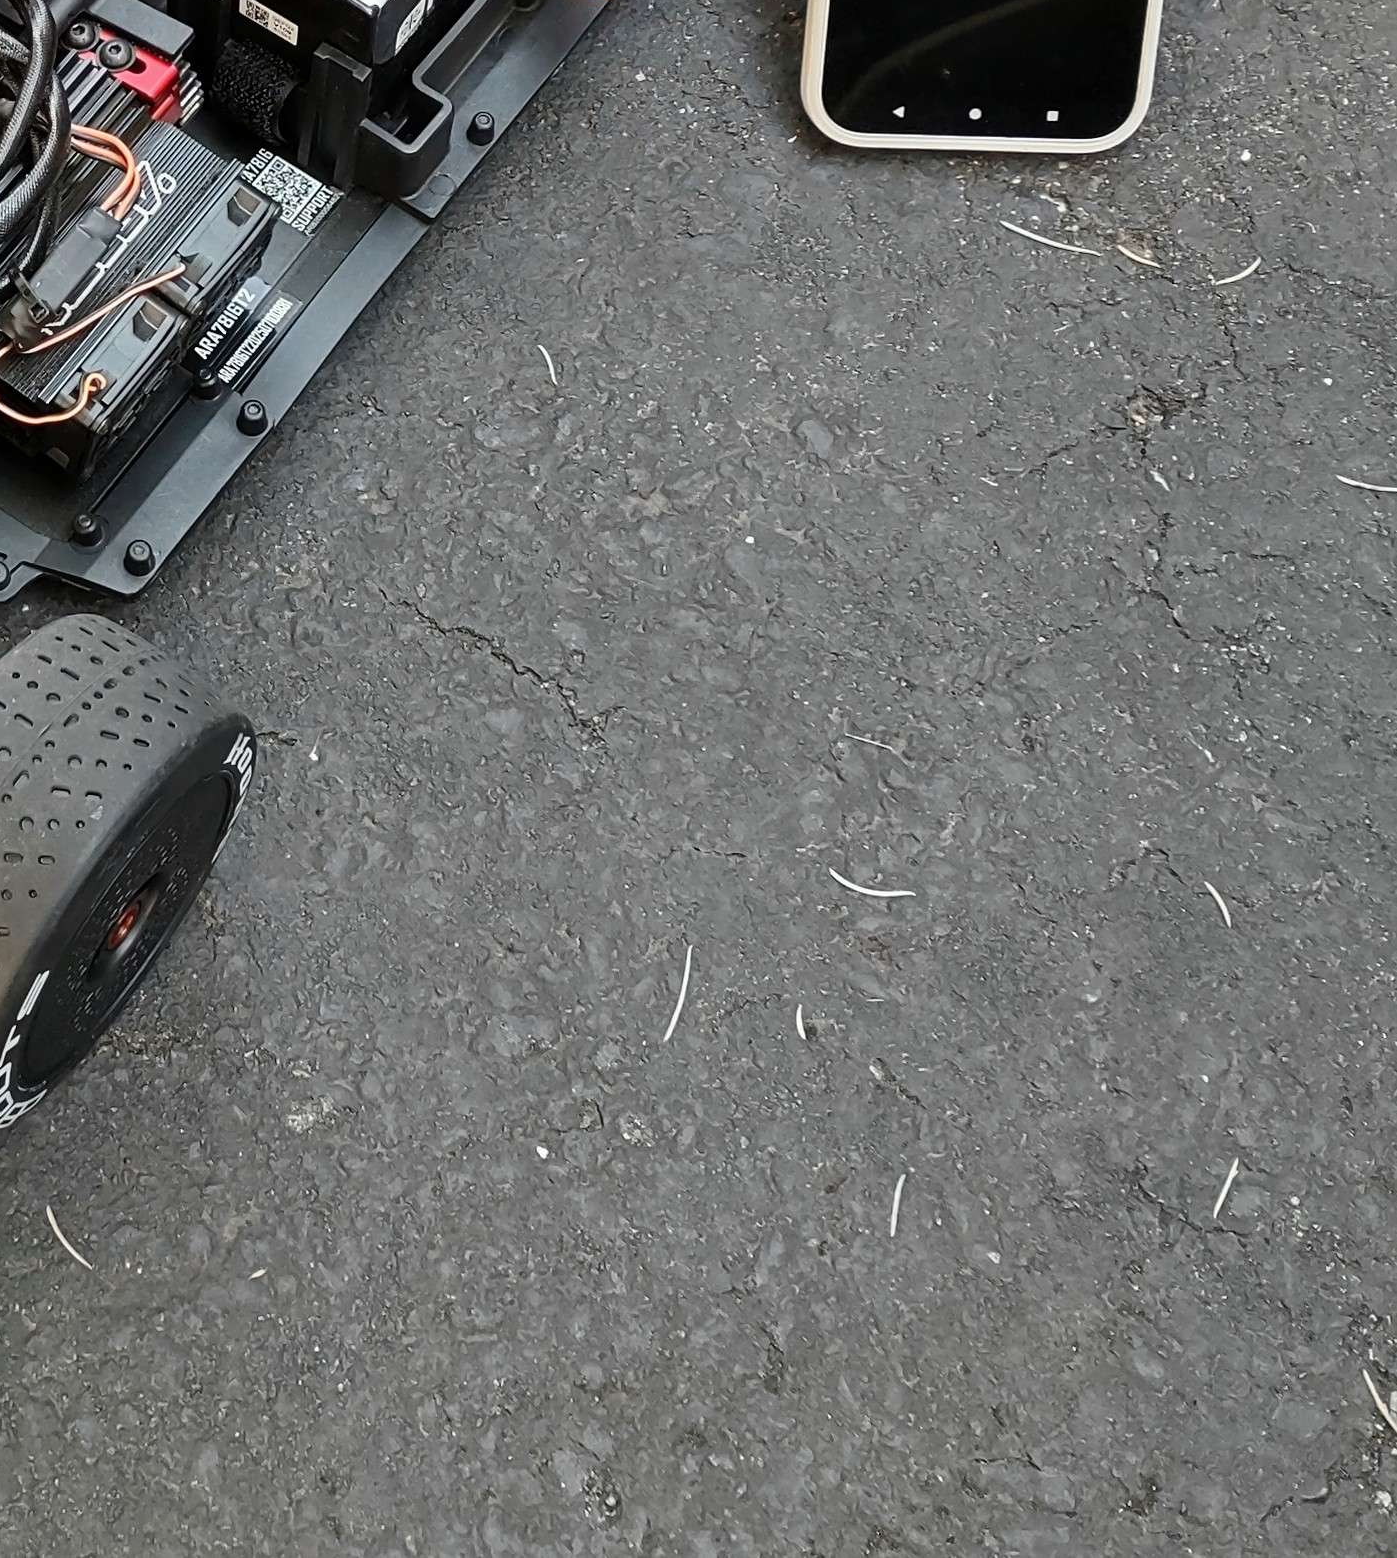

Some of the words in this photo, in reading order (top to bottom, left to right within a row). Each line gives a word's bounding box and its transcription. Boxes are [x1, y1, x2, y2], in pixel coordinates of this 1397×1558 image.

[241, 147, 274, 185] A7816
[291, 185, 333, 232] SUPPORT
[194, 287, 255, 360] ARA7816T2
